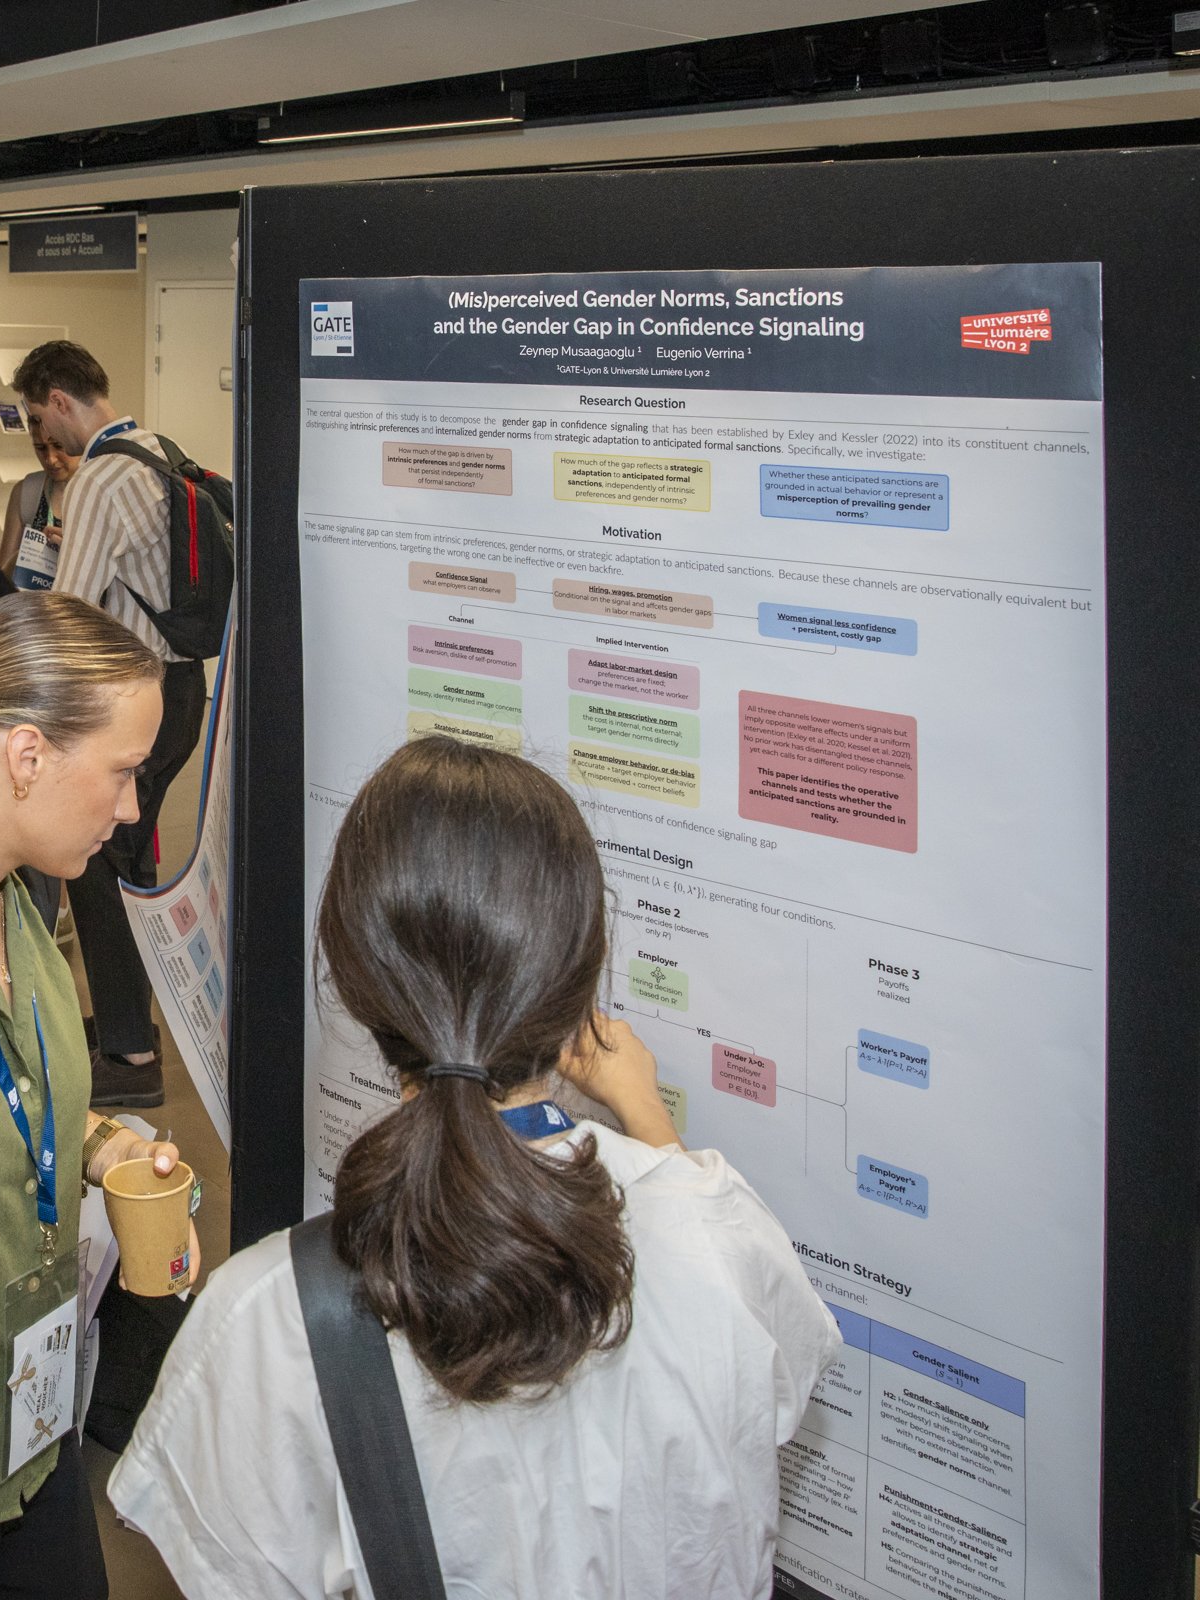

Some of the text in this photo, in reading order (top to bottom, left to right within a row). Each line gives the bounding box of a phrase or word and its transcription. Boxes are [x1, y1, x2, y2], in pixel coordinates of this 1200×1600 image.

[45, 232, 95, 244] Accès RDC Bas
[37, 244, 103, 256] et sous sol Accueil
[448, 287, 844, 311] (Mis)perceived Gender Norms, Sanctions
[313, 317, 352, 333] GATE
[433, 316, 864, 341] and the Gender Gap in Confidence Signaling
[519, 345, 559, 359] Zeynep
[562, 346, 635, 360] Musaagaoglu
[656, 346, 702, 361] Eugenio
[703, 347, 745, 359] Verrina
[1019, 342, 1028, 352] 2
[602, 366, 610, 375] &
[610, 366, 650, 375] Université
[650, 367, 683, 376] Lumière
[684, 368, 704, 378] Lyon
[704, 369, 710, 377] 2
[579, 395, 686, 409] Research Question
[768, 470, 805, 479] Whether
[806, 472, 830, 481] these
[831, 475, 880, 484] anticipated
[881, 478, 924, 487] sanctions
[764, 482, 806, 491] grounded
[844, 486, 882, 496] behavior
[894, 491, 936, 500] represent
[776, 493, 931, 511] misperception of prevailing gender
[836, 510, 869, 518] norms?
[24, 529, 45, 544] ASFEE
[602, 525, 662, 540] Motivation
[435, 571, 488, 584] Confidence Signal
[448, 615, 475, 624] Channel
[777, 613, 897, 634] Women signal less confidence
[798, 626, 882, 643] persistent, costly gap
[434, 640, 494, 655] Intrinsic preferences
[596, 636, 669, 652] Implied Intervention
[587, 659, 678, 679] Adapt labor-market design
[442, 685, 485, 698] Gender norms
[757, 766, 900, 800] This paper identifies the operative
[761, 779, 893, 810] channels and tests whether the
[748, 788, 906, 825] anticipated sanctions are grounded in
[811, 812, 839, 824] reality.
[596, 839, 693, 869] erimental Design
[637, 899, 681, 918] Phase 2
[638, 950, 678, 967] Employer
[868, 958, 920, 980] Phase 3
[878, 976, 910, 991] Payoffs
[877, 990, 911, 1004] realized
[613, 1002, 624, 1011] NO
[696, 1028, 711, 1038] YES
[860, 1040, 928, 1065] Worker's Payoff
[349, 1071, 401, 1100] Treatments
[318, 1083, 362, 1110] Treatments
[869, 1164, 916, 1186] Employer's
[879, 1178, 906, 1193] Payoff
[791, 1241, 912, 1297] tification Strategy
[912, 1350, 980, 1384] Gender Salient
